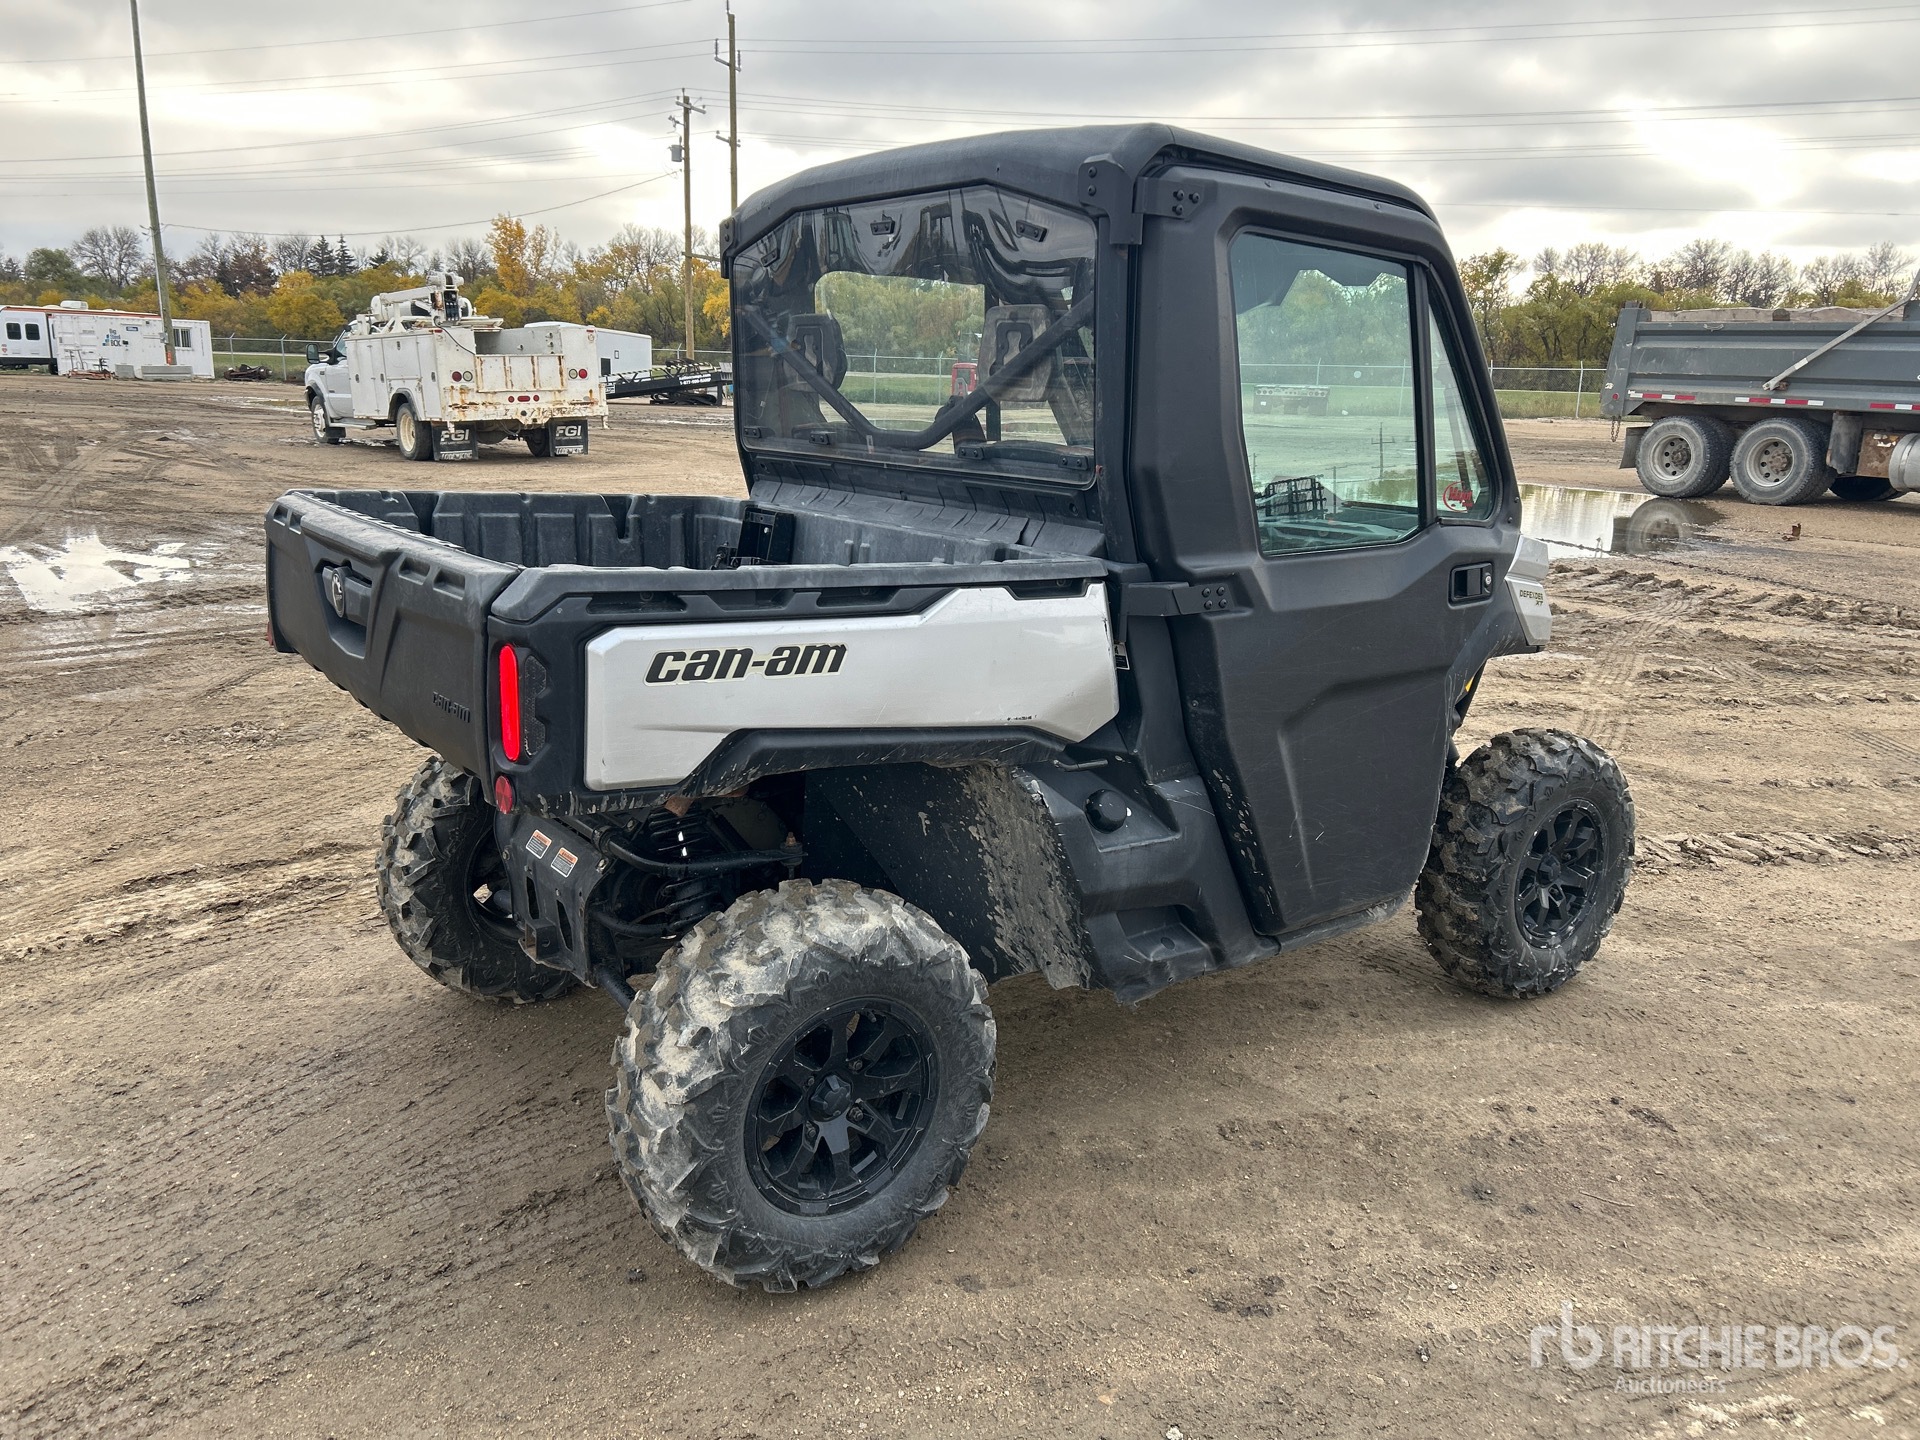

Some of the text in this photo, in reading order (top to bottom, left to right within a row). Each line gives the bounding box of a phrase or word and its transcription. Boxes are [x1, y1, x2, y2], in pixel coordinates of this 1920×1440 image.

[440, 429, 470, 442] FGI
[555, 425, 582, 437] FGI
[1520, 590, 1544, 600] DEFENDER
[645, 644, 848, 683] can-am
[433, 691, 471, 723] can-am
